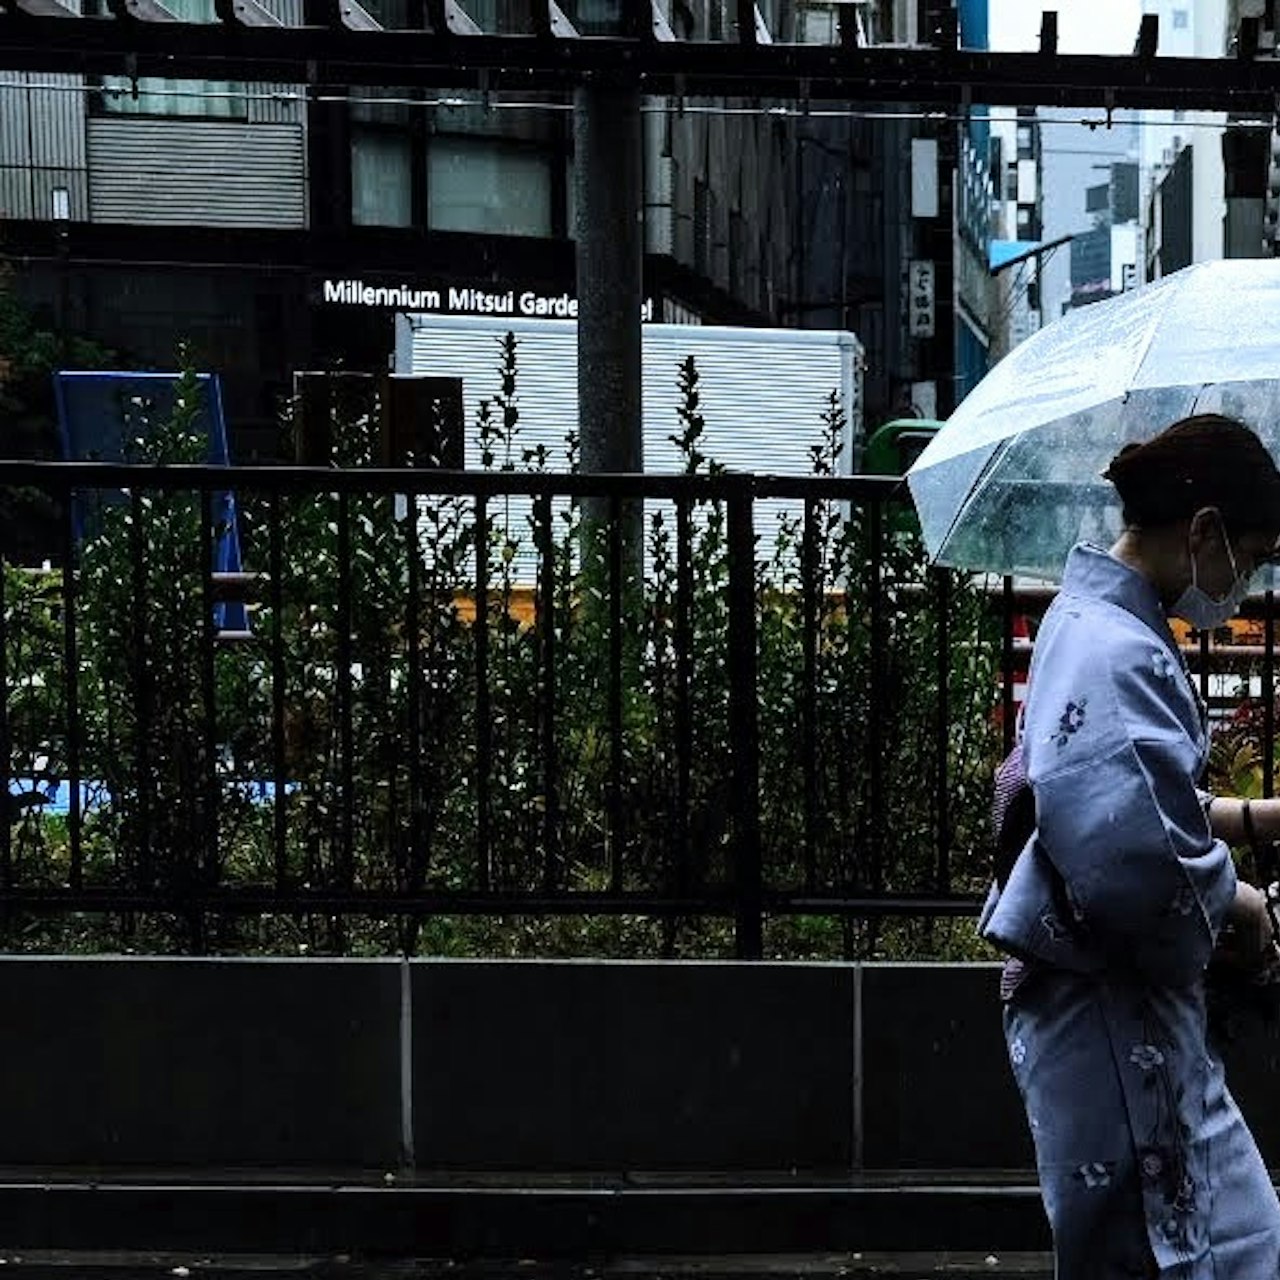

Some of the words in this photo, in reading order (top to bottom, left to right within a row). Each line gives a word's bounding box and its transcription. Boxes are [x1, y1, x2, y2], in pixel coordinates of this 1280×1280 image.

[323, 279, 441, 309] Millennium
[447, 286, 514, 313] Mitsui
[519, 292, 579, 317] Garde
